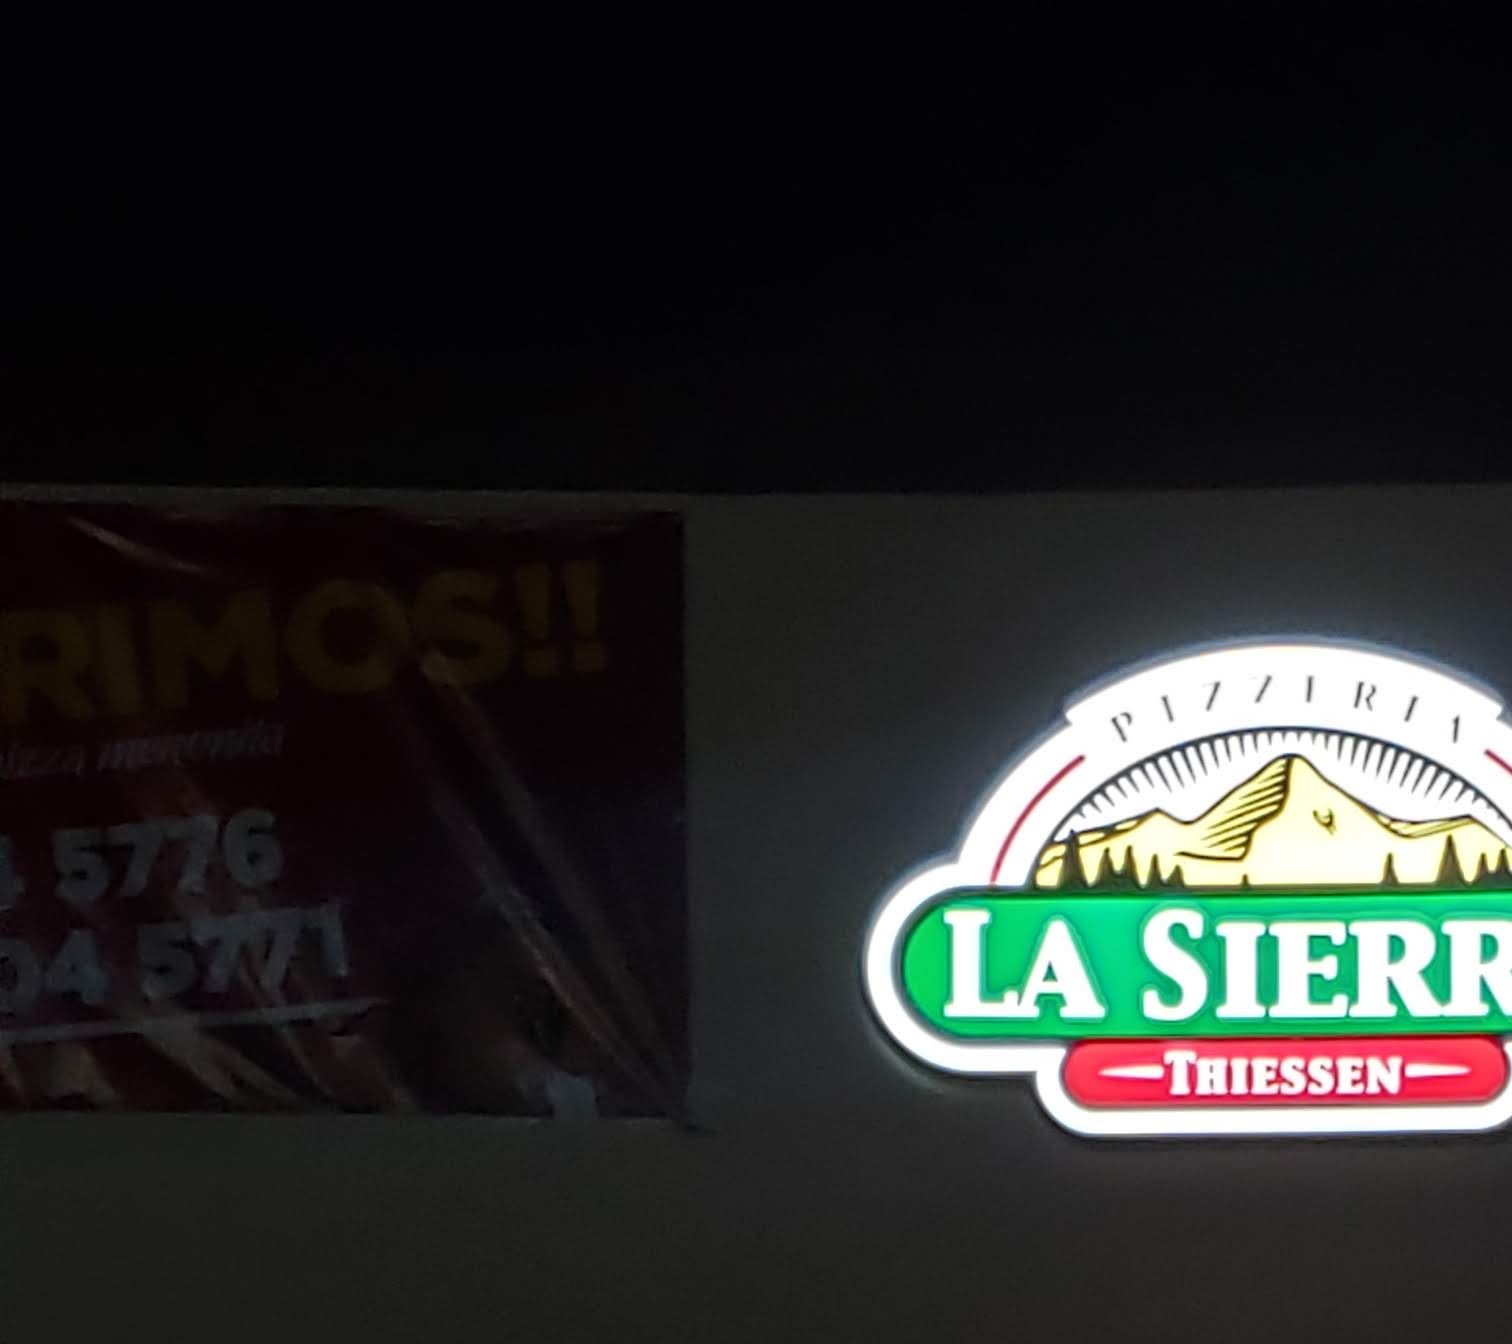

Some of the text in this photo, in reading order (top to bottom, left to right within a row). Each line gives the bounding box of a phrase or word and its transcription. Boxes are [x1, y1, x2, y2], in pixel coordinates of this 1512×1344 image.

[51, 808, 285, 903] 5776
[943, 909, 1107, 1021] LA
[1163, 1048, 1404, 1097] THIESSEN
